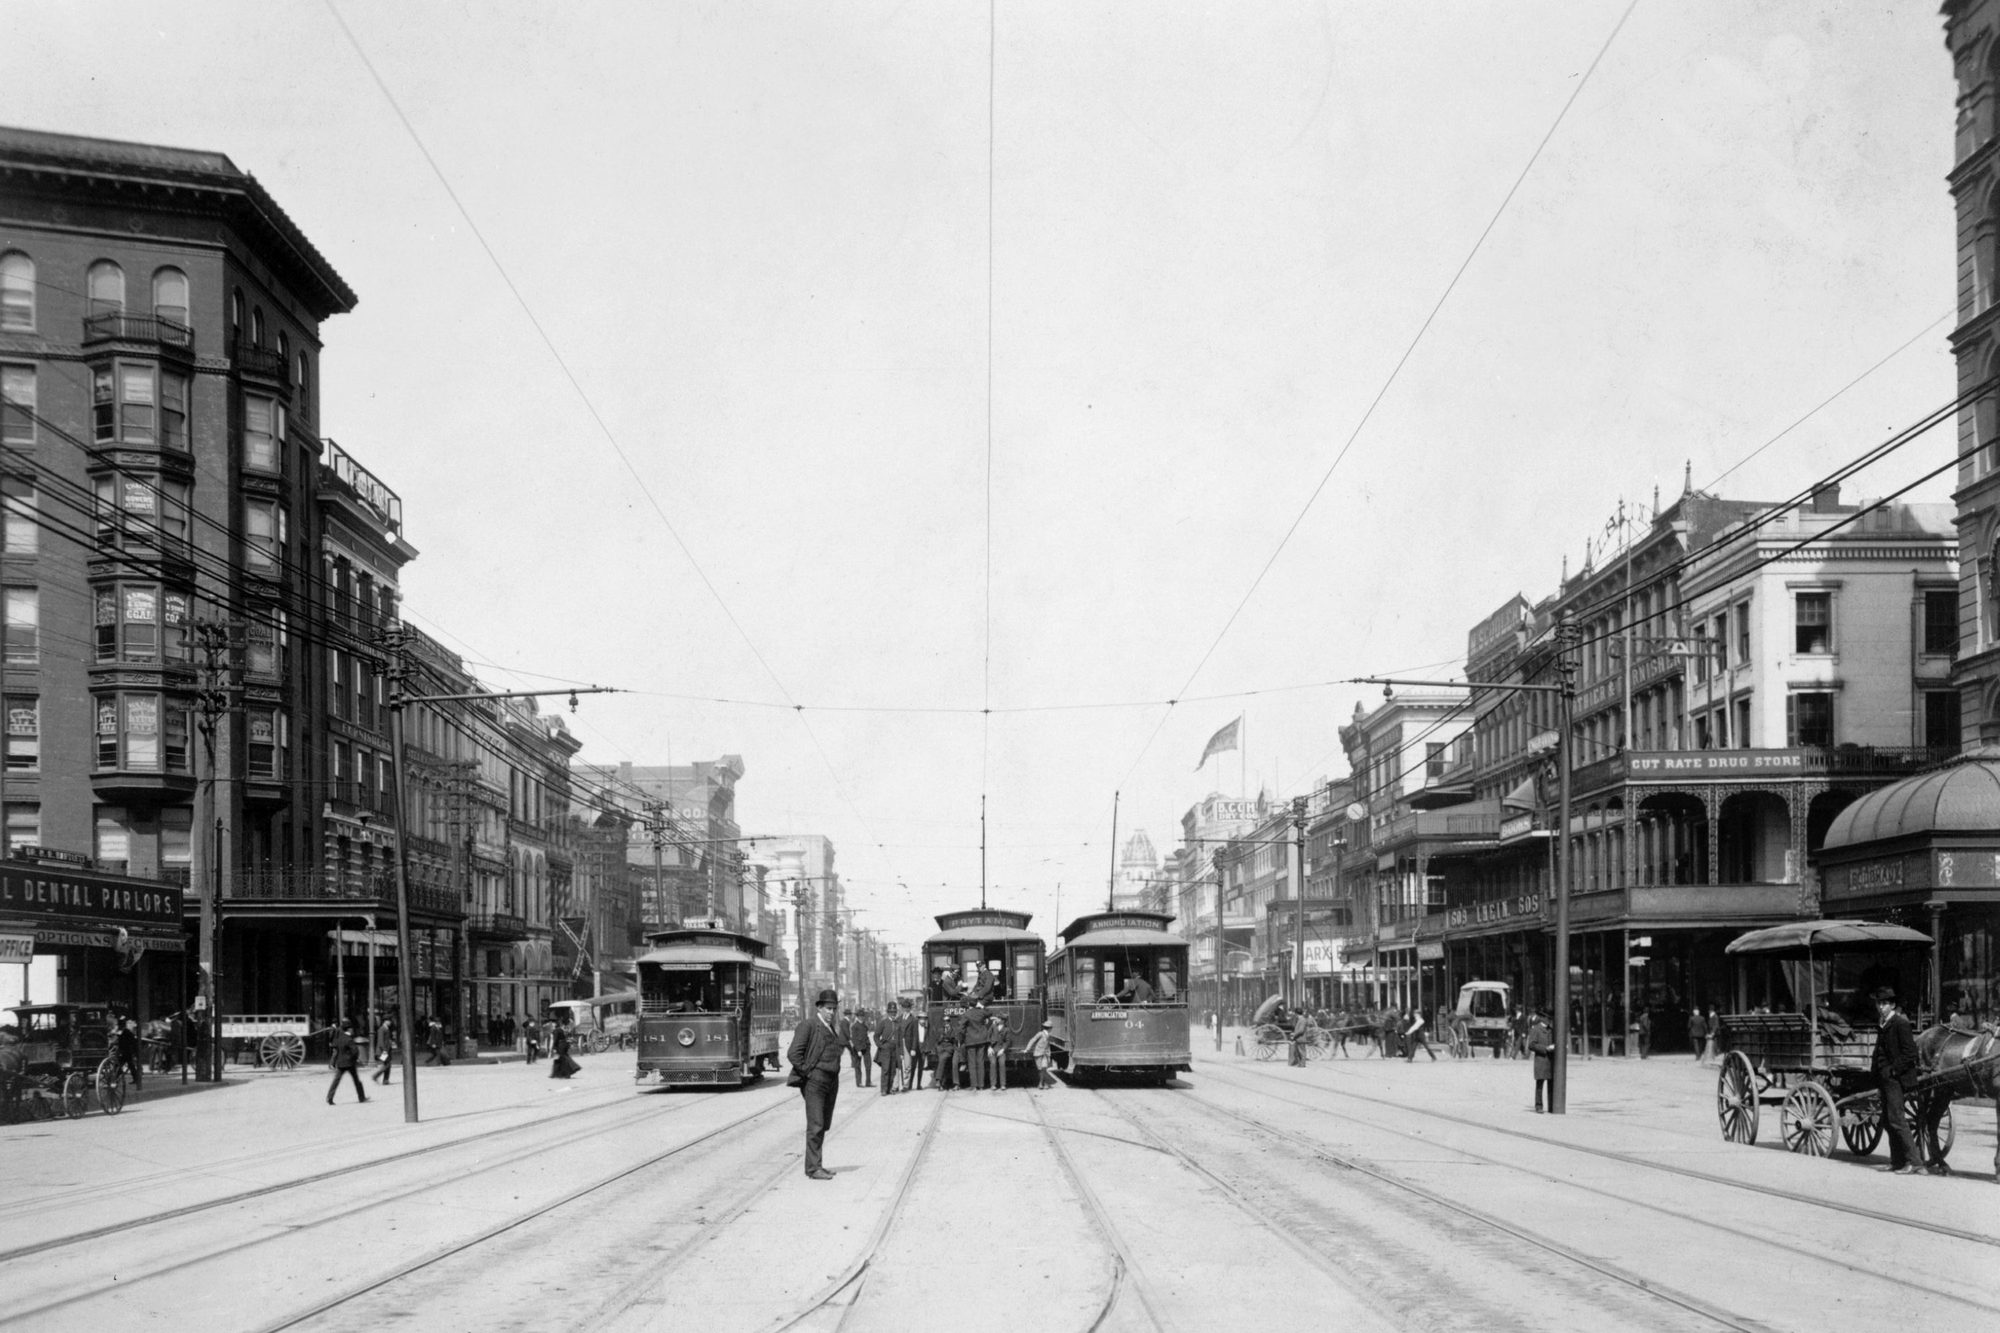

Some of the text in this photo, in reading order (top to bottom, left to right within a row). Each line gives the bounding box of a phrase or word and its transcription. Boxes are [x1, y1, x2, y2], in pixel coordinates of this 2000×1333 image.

[127, 610, 152, 619] COAL
[165, 613, 180, 623] COA
[1631, 755, 1801, 769] CUT RATE DRUG STORE
[1218, 802, 1259, 813] B.COH
[25, 879, 93, 907] DENTAL
[102, 888, 175, 914] PARLORS.
[951, 917, 1014, 928] PRYTANIA
[1092, 917, 1160, 929] ANNUNCIATION
[37, 931, 112, 947] OPTICIANS
[943, 1008, 969, 1016] SPECI
[644, 1033, 729, 1042] 181 181
